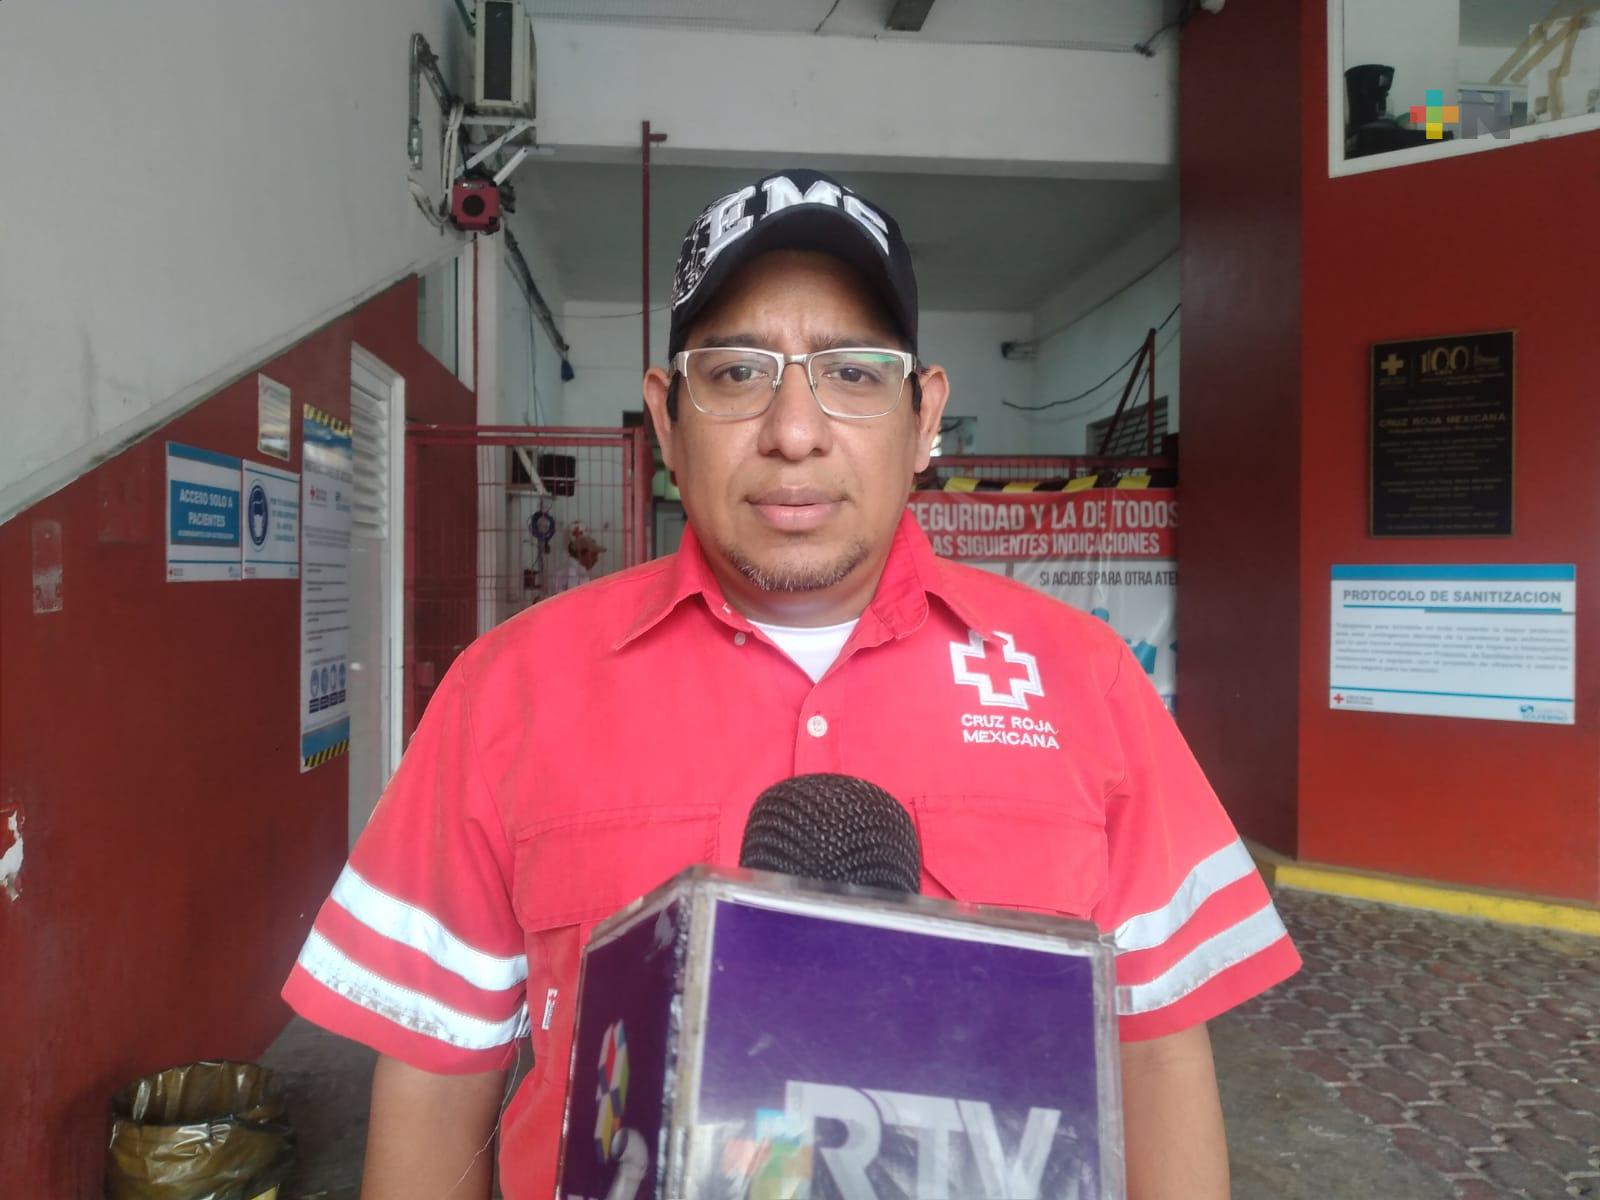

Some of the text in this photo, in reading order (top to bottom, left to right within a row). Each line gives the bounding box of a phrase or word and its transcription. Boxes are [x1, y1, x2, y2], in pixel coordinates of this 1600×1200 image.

[1412, 416, 1442, 426] ROJA
[1446, 413, 1505, 424] MEXICANA
[179, 488, 233, 508] ACCESO SOLO A
[188, 511, 226, 528] PACIENTES
[1030, 503, 1046, 529] Y
[1051, 501, 1077, 529] LA
[1082, 500, 1106, 528] DE
[933, 532, 1160, 556] AS SIGUIENTES INDICACIONES
[1040, 571, 1050, 586] SI
[1124, 571, 1152, 586] OTRA
[1343, 589, 1561, 604] PROTOCOLO DE SANITIZACION
[961, 713, 1057, 735] CRUZ ROJA
[963, 729, 1060, 750] MEXICANA
[786, 1079, 1061, 1200] RTV
